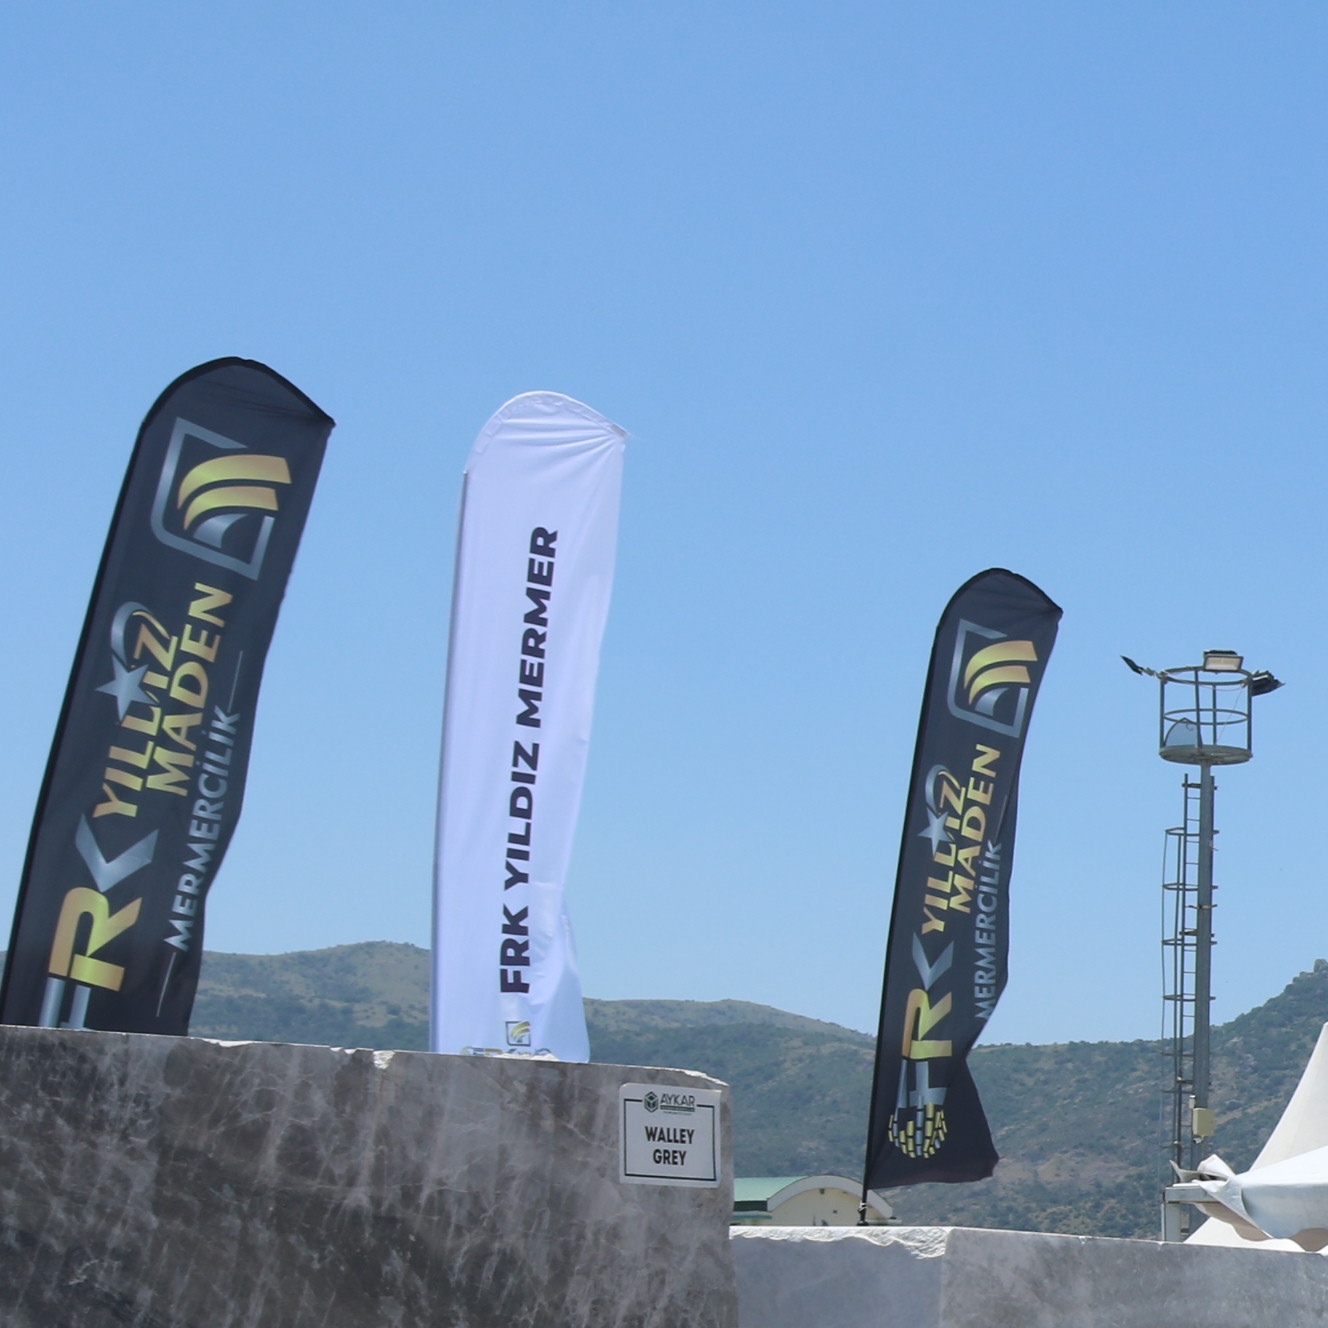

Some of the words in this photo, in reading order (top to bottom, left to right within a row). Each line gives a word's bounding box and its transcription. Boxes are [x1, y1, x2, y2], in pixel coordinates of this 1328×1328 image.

[146, 582, 233, 797] MADEN
[515, 525, 559, 729] MERMER
[163, 704, 241, 952] MERMERCİLİK
[504, 739, 541, 893] YILDIZ
[948, 743, 1001, 914] MADEN
[500, 902, 531, 994] FRK
[973, 838, 1003, 1020] MERMERCİLİK
[660, 1093, 696, 1107] AYKAR
[897, 931, 955, 1109] FRK
[645, 1125, 695, 1145] WALLEY
[652, 1148, 687, 1166] GREY
